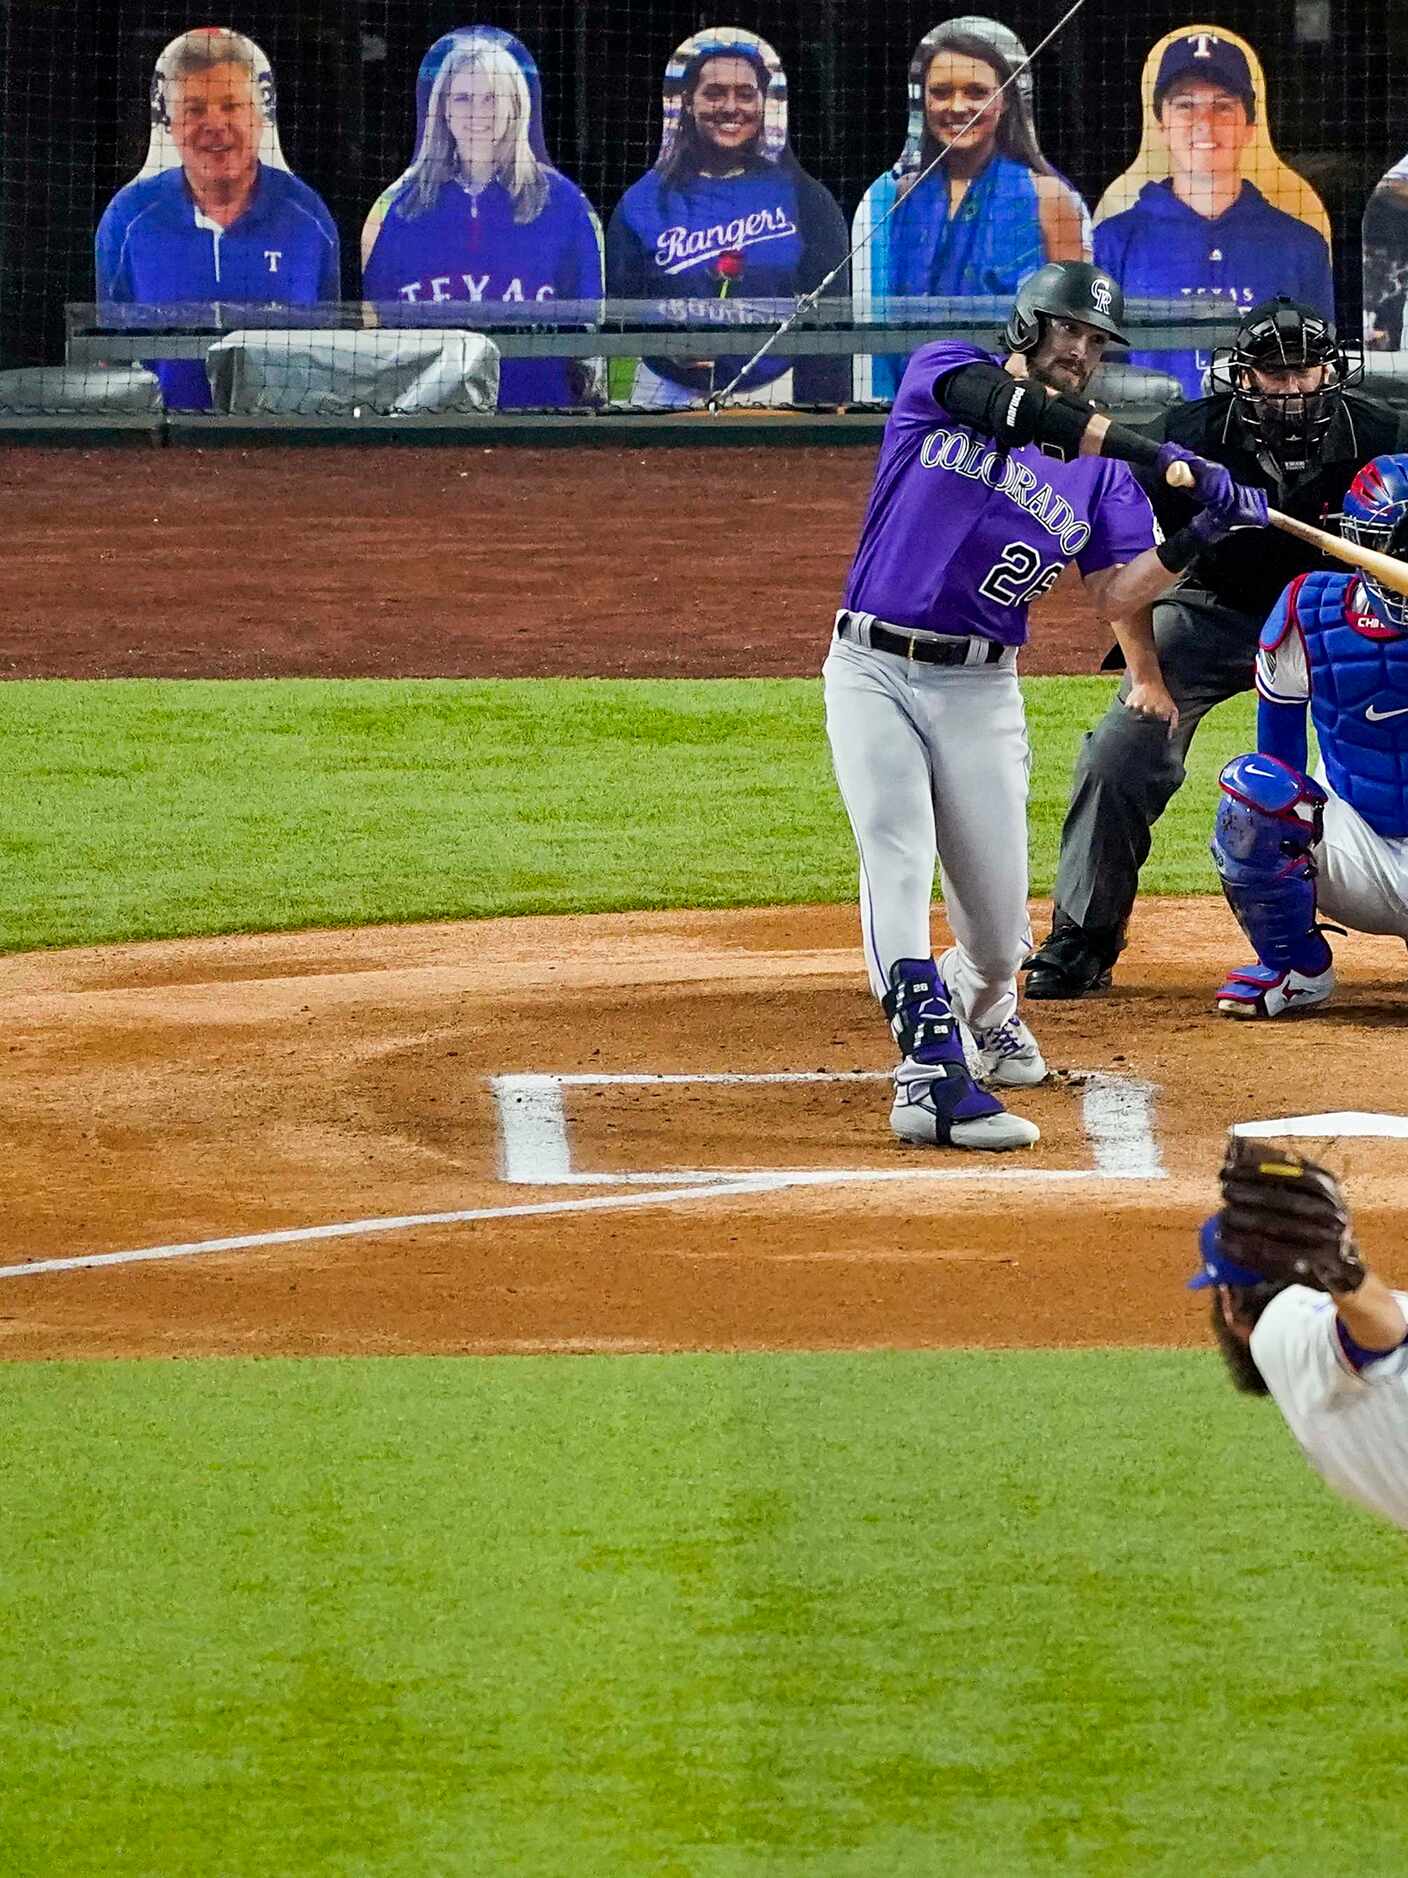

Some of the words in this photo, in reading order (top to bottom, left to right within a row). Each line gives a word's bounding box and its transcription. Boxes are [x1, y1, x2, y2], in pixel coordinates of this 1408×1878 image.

[1187, 33, 1218, 58] T
[263, 250, 283, 272] T
[655, 206, 797, 275] Rangers
[920, 429, 1091, 556] COLORADO
